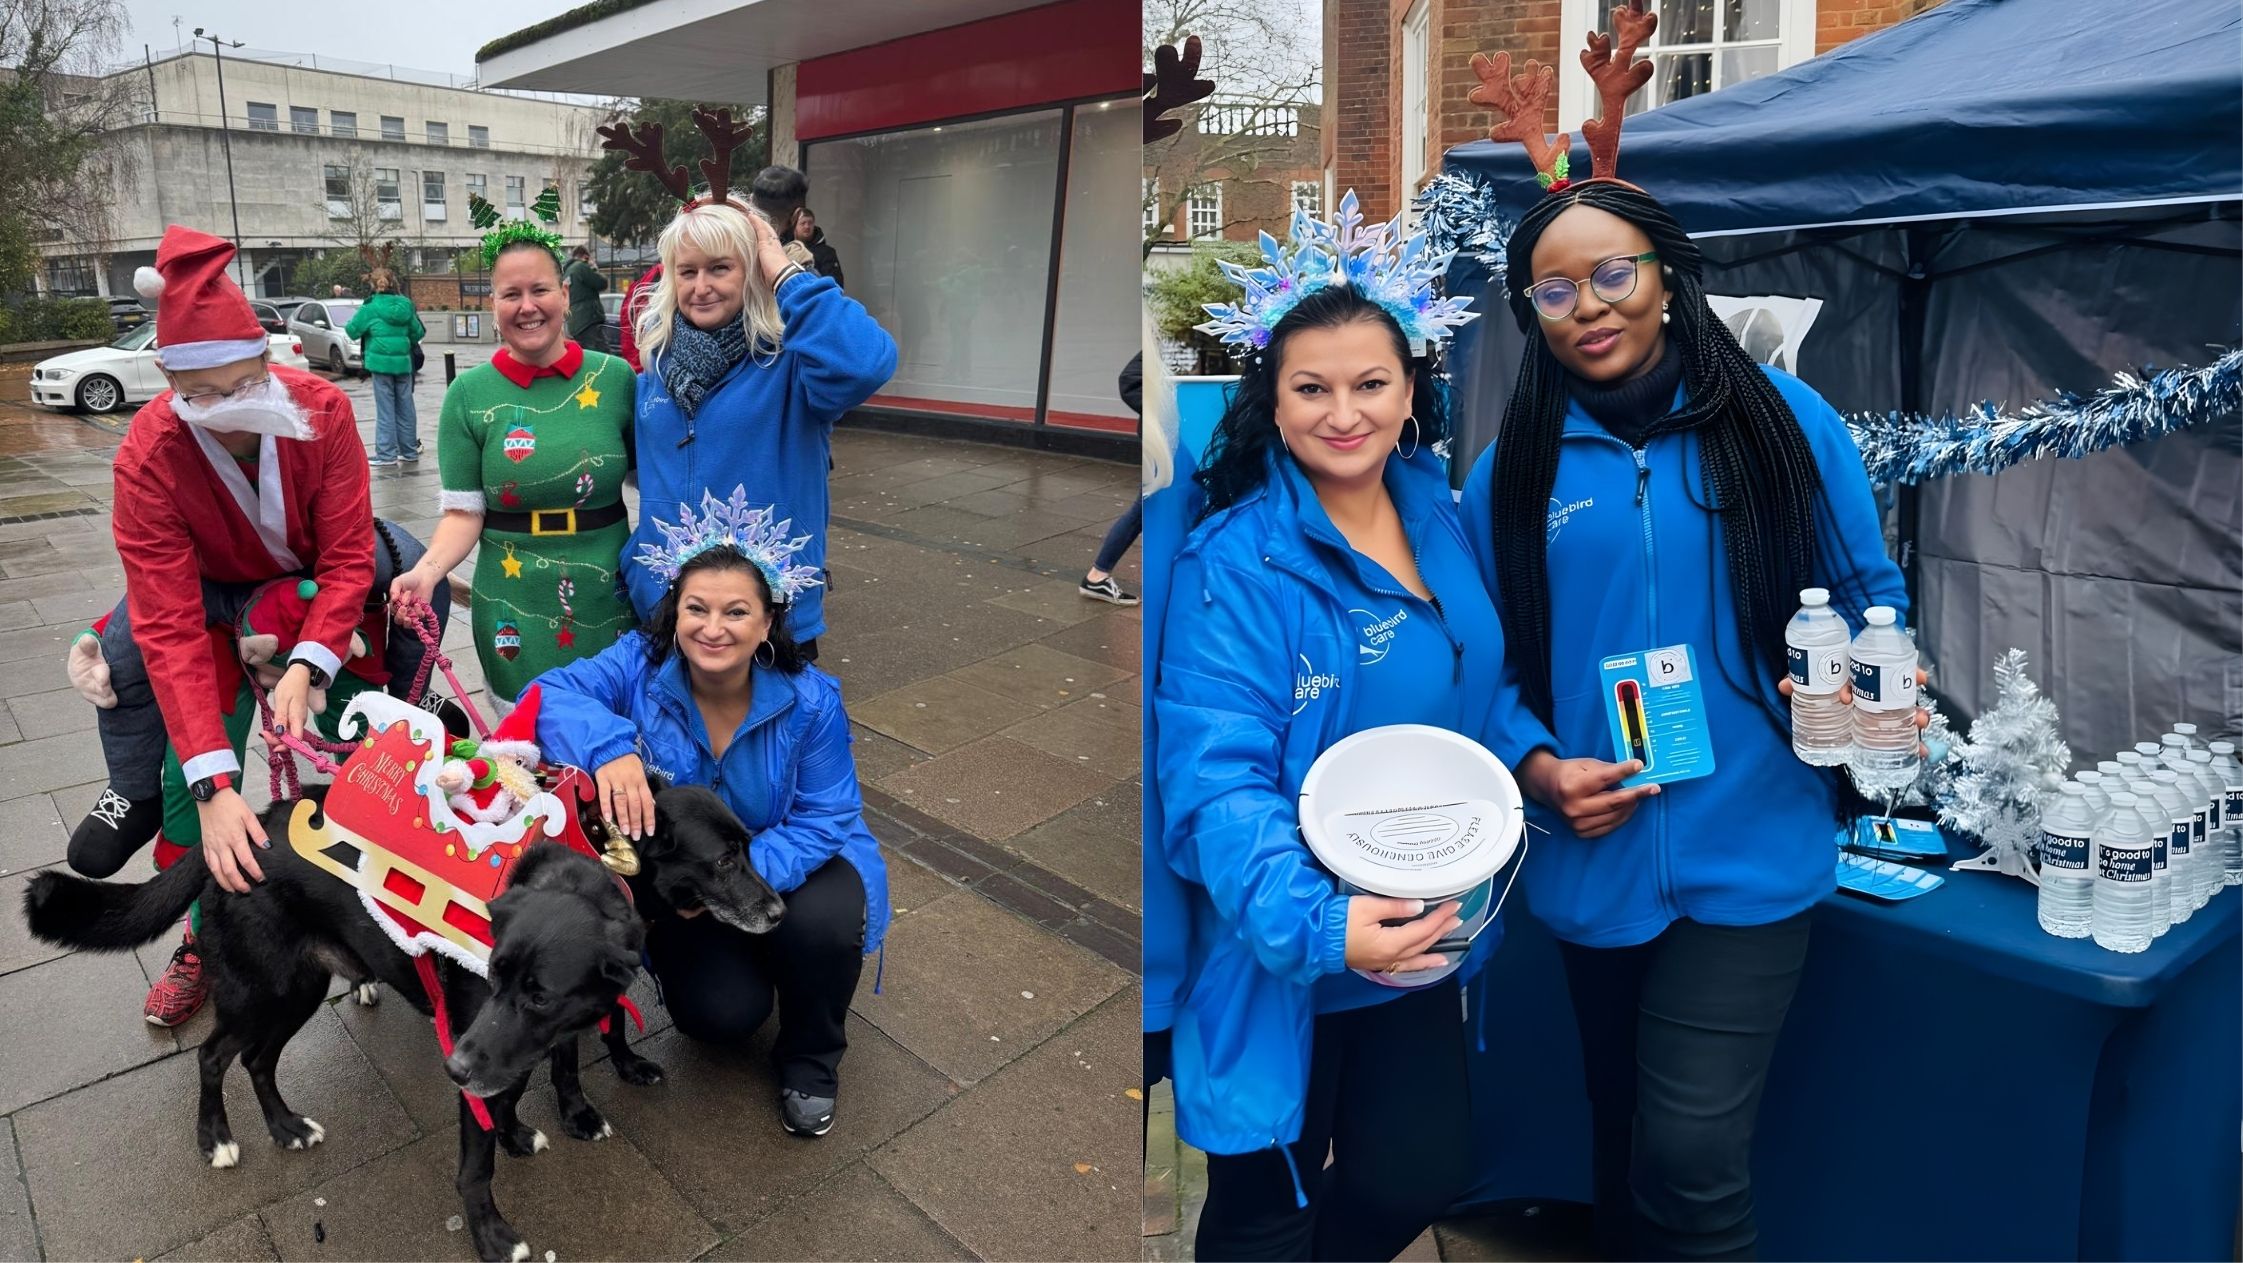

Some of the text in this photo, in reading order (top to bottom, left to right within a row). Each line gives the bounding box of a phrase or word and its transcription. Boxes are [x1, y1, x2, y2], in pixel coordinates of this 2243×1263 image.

[1363, 608, 1408, 637] bluebird
[1370, 630, 1395, 645] care
[1295, 687, 1320, 699] are
[370, 752, 408, 787] MERRY
[347, 762, 404, 815] CHRISTMAS
[2112, 850, 2141, 861] good
[2142, 850, 2150, 860] to
